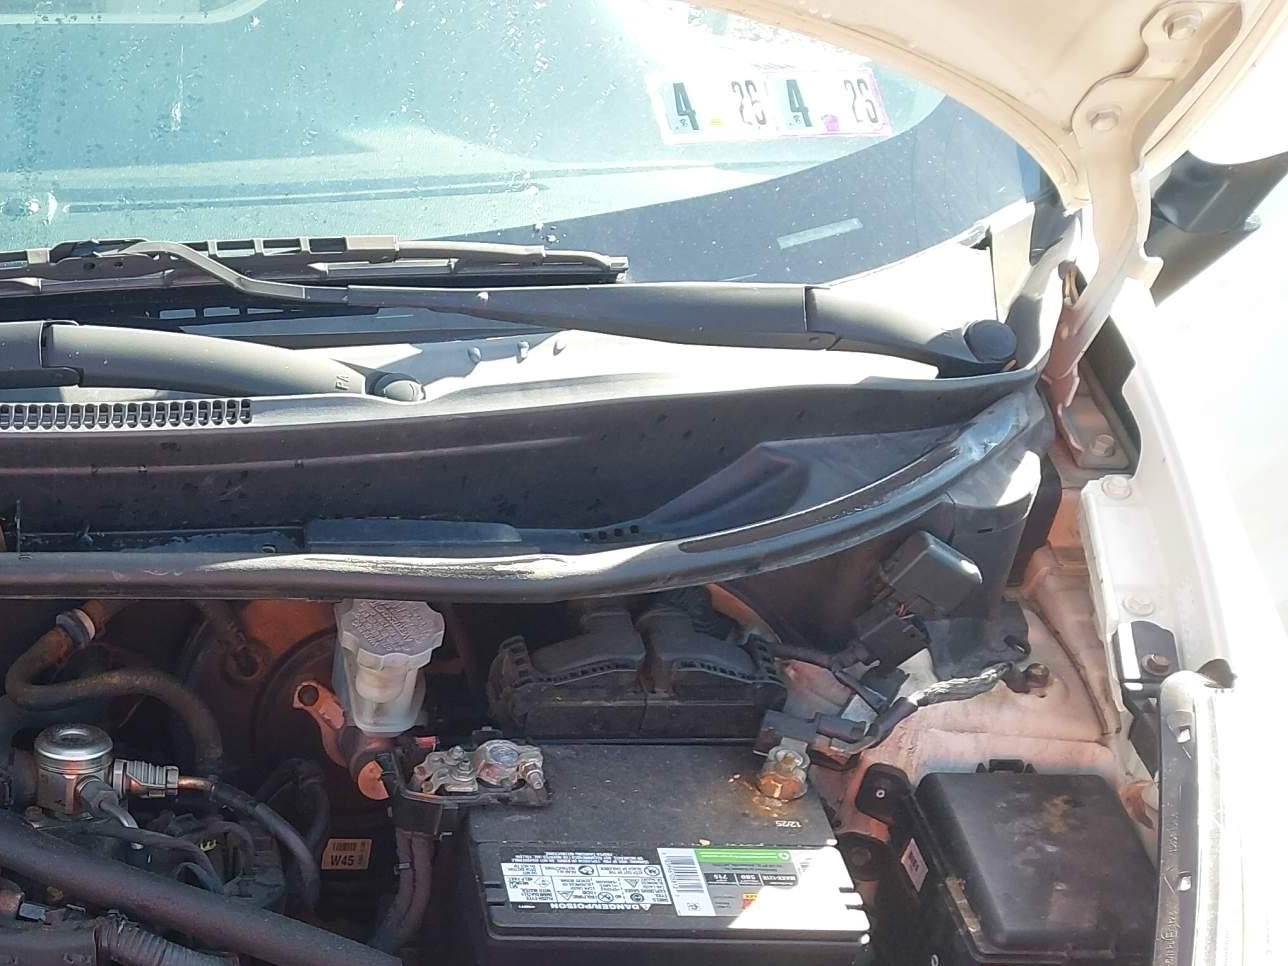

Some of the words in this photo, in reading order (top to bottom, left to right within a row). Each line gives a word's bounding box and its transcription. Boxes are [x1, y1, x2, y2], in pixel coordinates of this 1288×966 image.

[672, 82, 699, 130] 4
[785, 79, 812, 127] 4
[330, 855, 355, 866] W45
